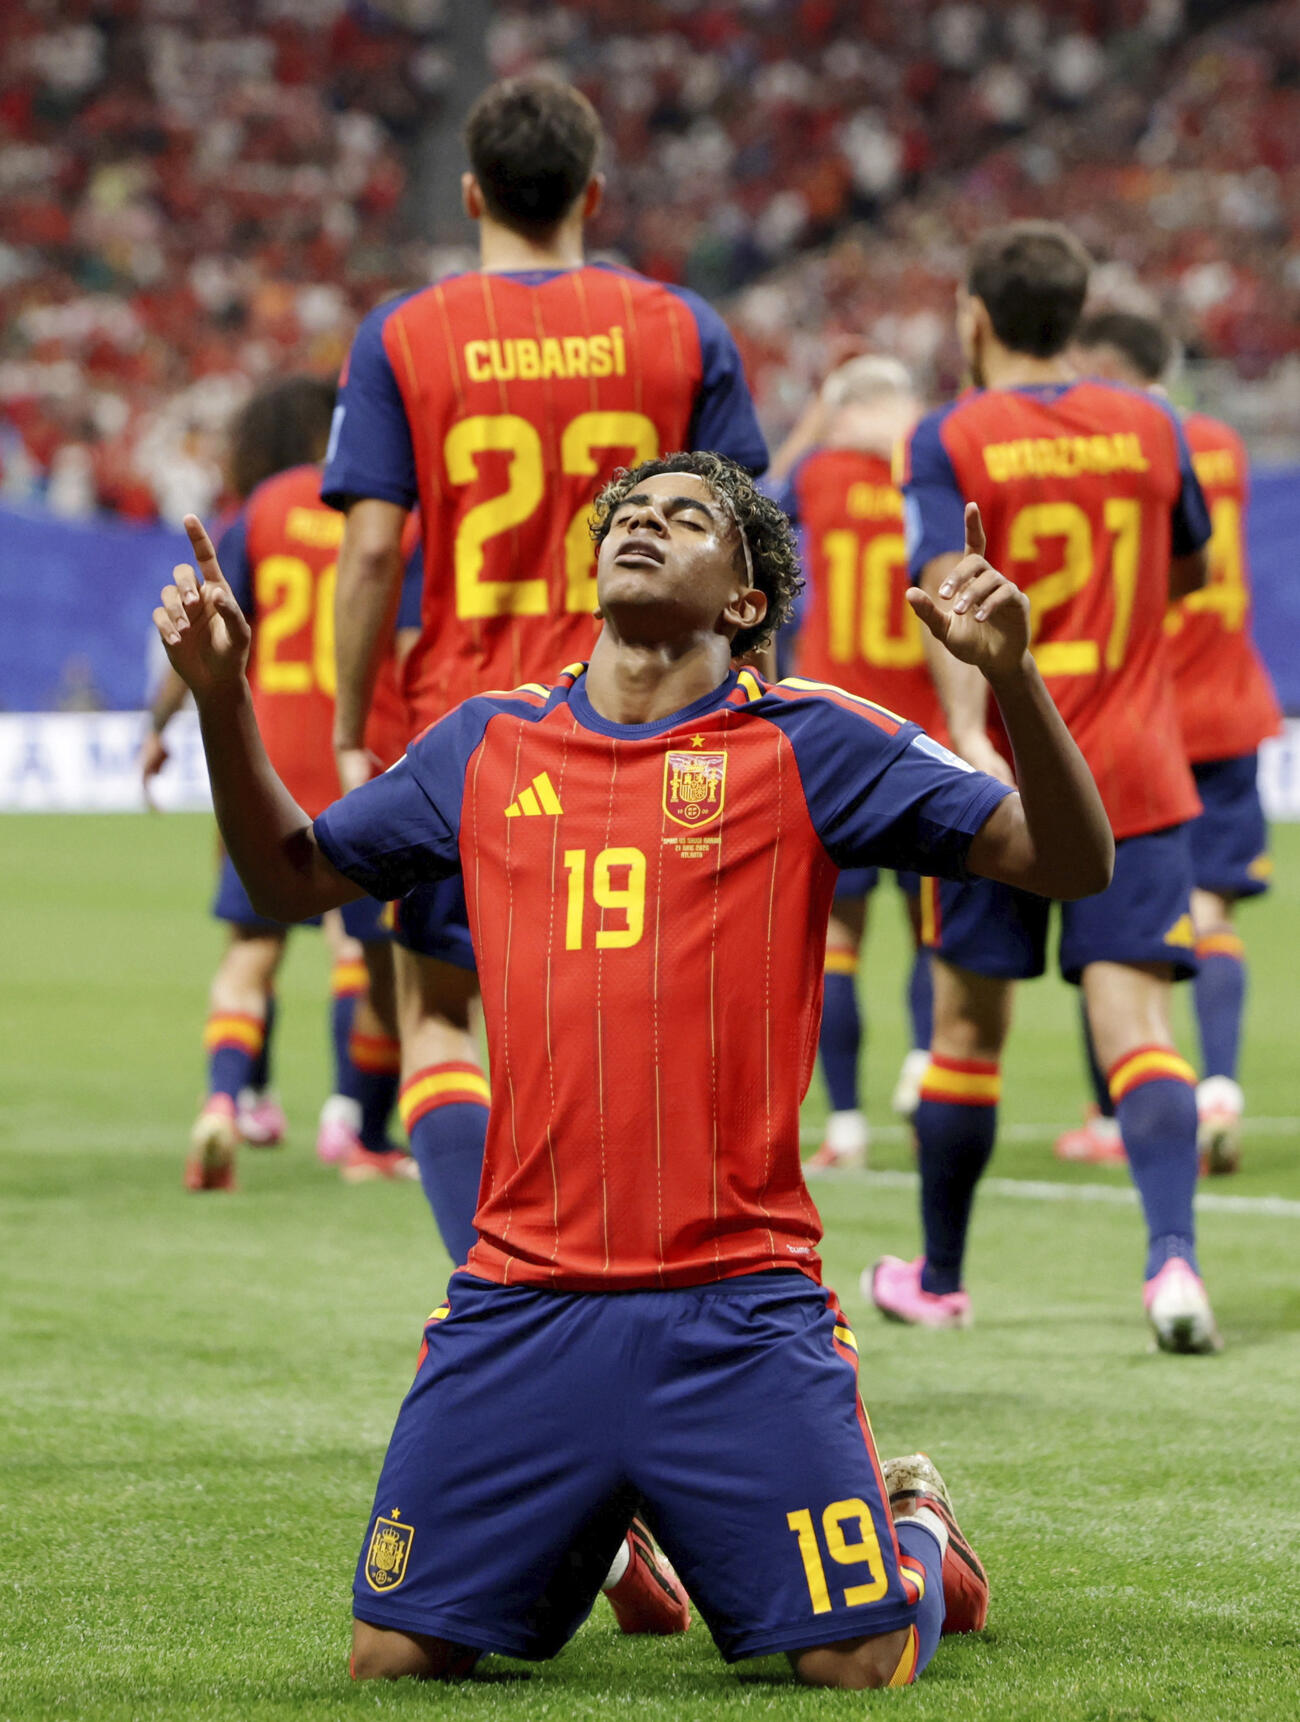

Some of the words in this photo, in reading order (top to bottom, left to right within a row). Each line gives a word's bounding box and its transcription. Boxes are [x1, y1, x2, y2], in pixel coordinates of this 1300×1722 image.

[464, 325, 627, 382] CUBARSÍ
[443, 411, 659, 620] 22
[822, 528, 925, 668] 10
[1008, 498, 1141, 677] 21
[564, 847, 647, 951] 19
[786, 1498, 888, 1615] 19
